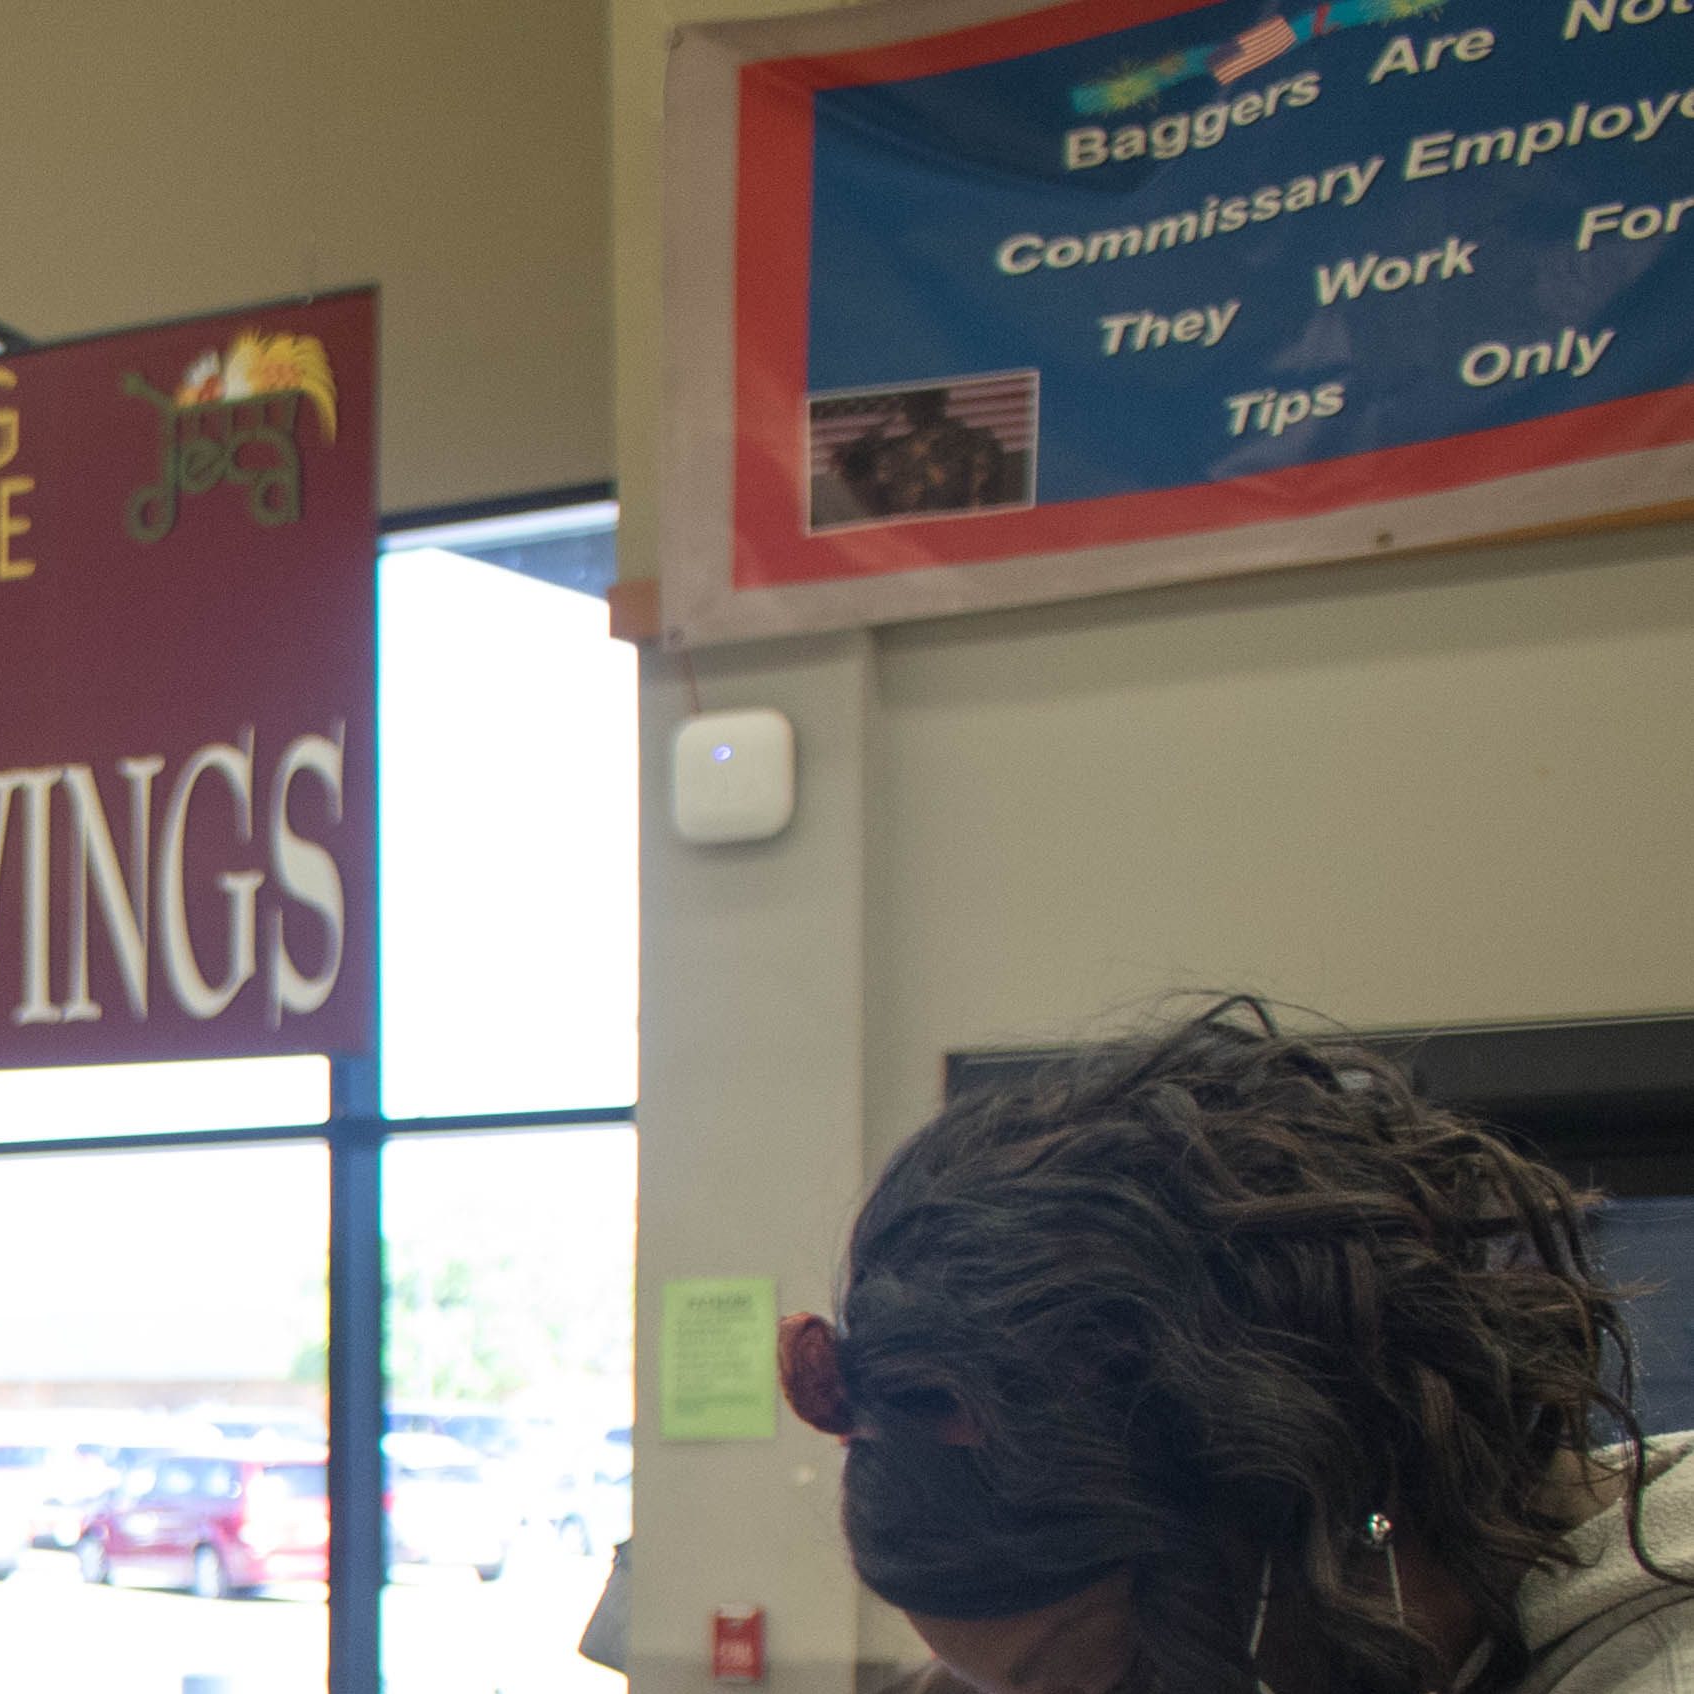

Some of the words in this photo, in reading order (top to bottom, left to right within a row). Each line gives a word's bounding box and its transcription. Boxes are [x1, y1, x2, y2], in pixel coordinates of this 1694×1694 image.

[1064, 70, 1320, 171] Baggers
[1368, 26, 1496, 86] Are
[996, 154, 1384, 276] Commissary
[1099, 298, 1240, 357] They
[1315, 238, 1477, 307] Work
[1576, 196, 1694, 251] For
[1227, 381, 1346, 437] Tips
[1459, 326, 1615, 388] Only
